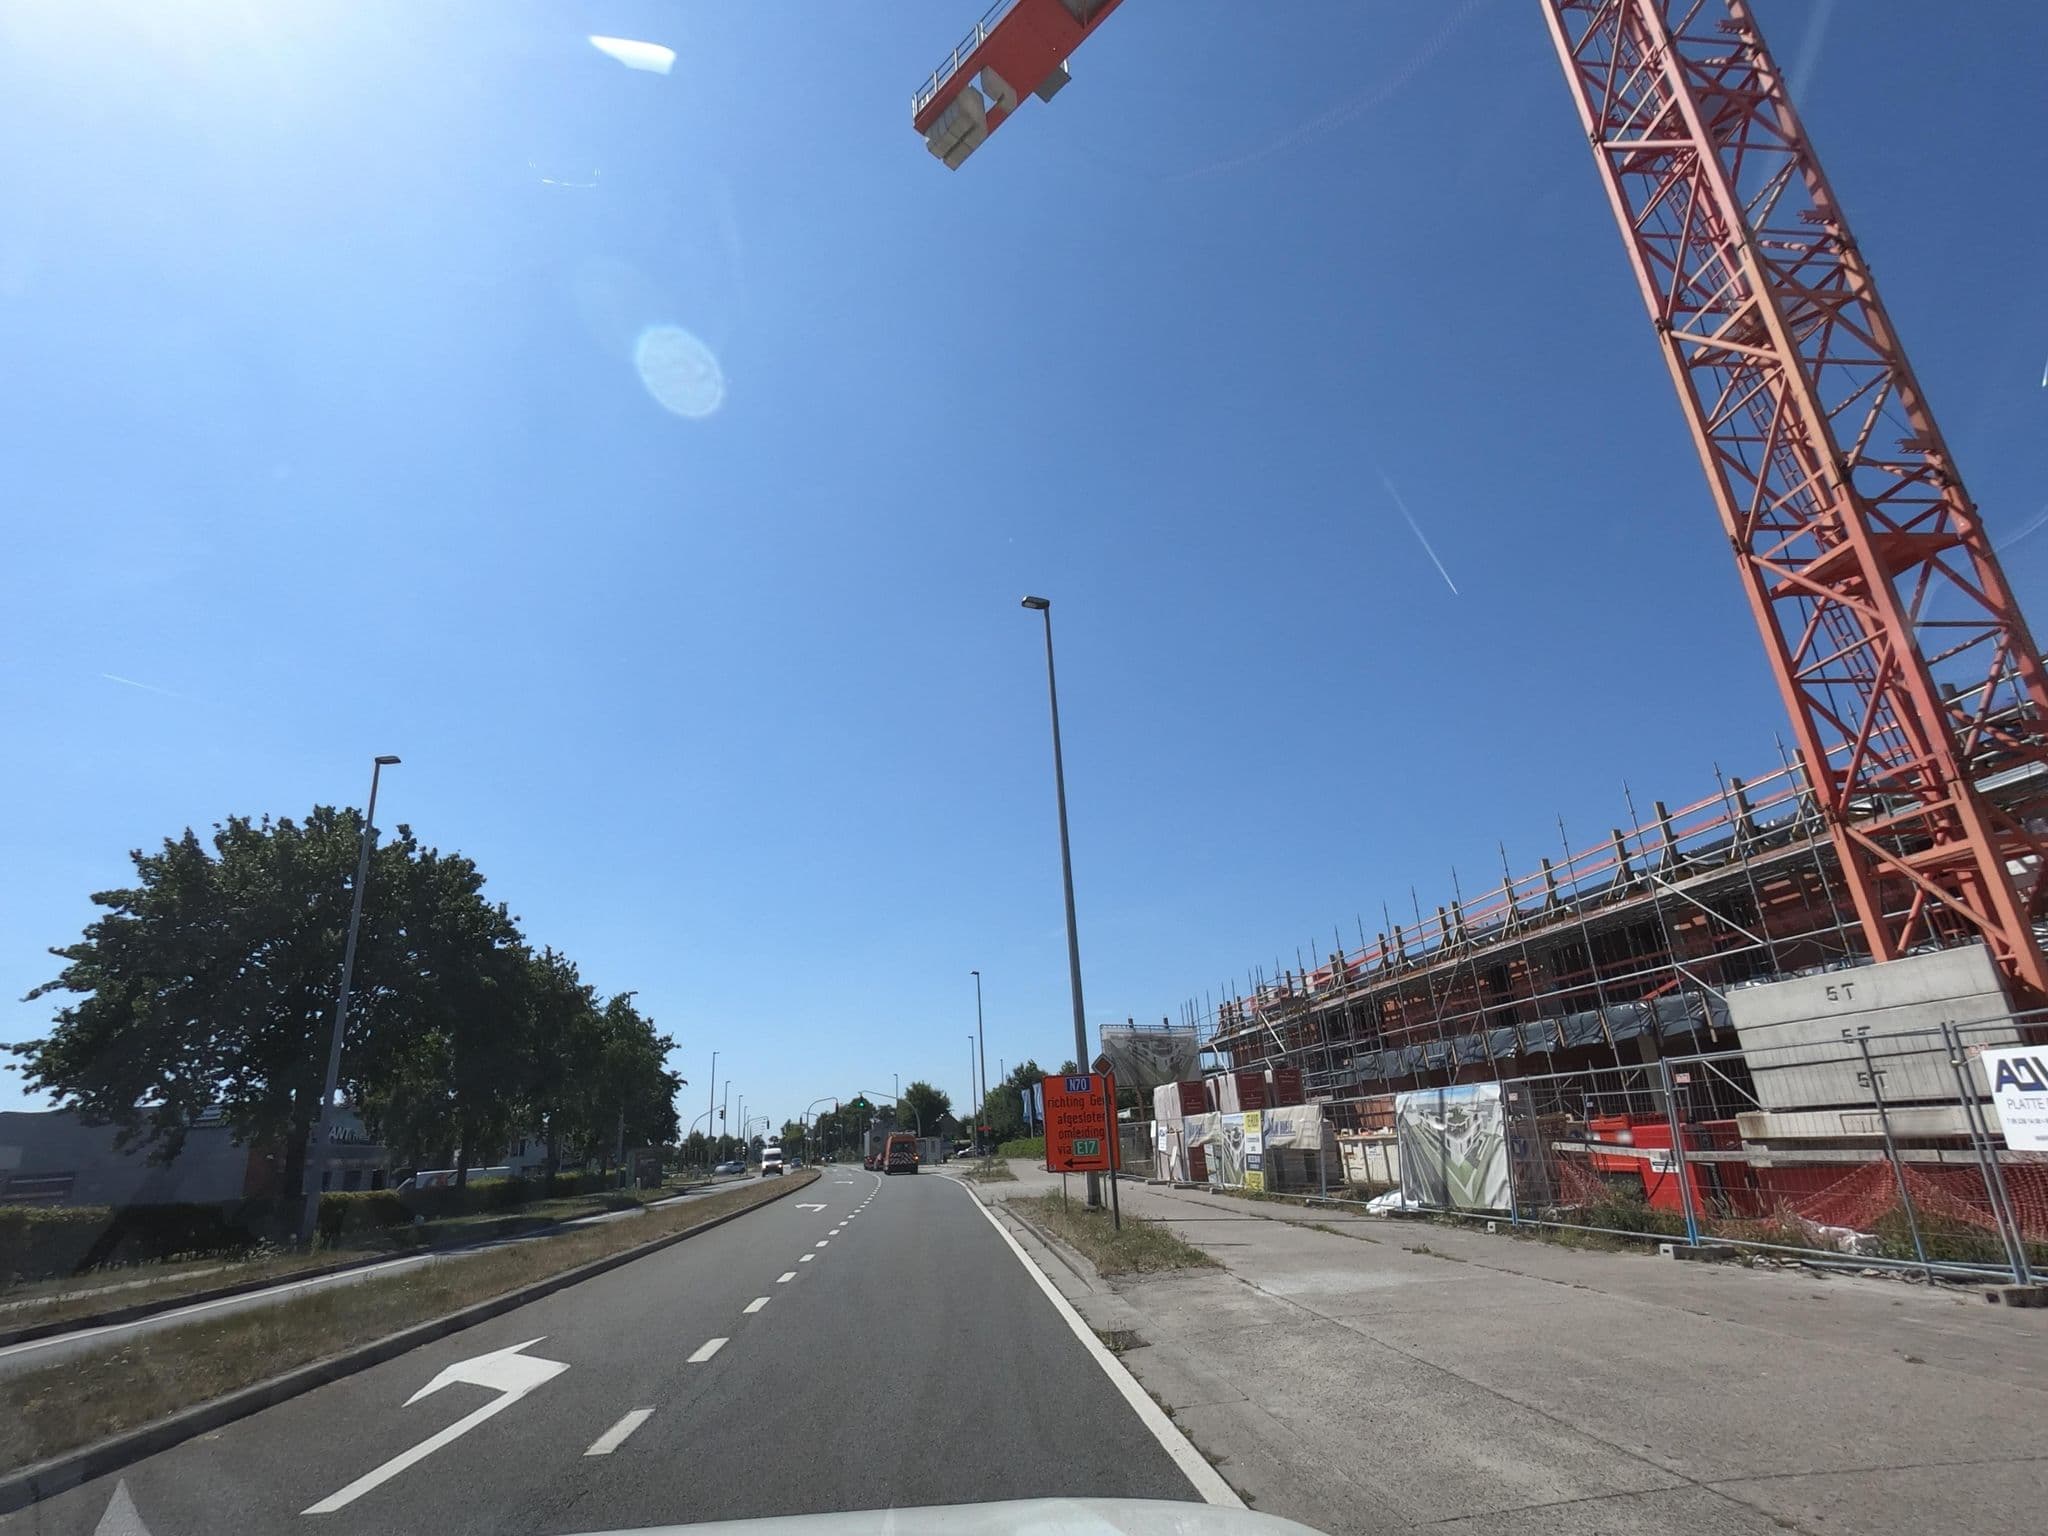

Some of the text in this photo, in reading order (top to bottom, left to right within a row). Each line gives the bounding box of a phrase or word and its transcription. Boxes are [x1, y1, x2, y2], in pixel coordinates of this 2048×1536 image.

[1826, 982, 1854, 1002] 5T
[1069, 1078, 1087, 1091] N70
[1048, 1097, 1085, 1109] richting
[2007, 1097, 2045, 1110] PLATTE
[1059, 1127, 1105, 1140] omleiding
[1057, 1141, 1096, 1155] via E17
